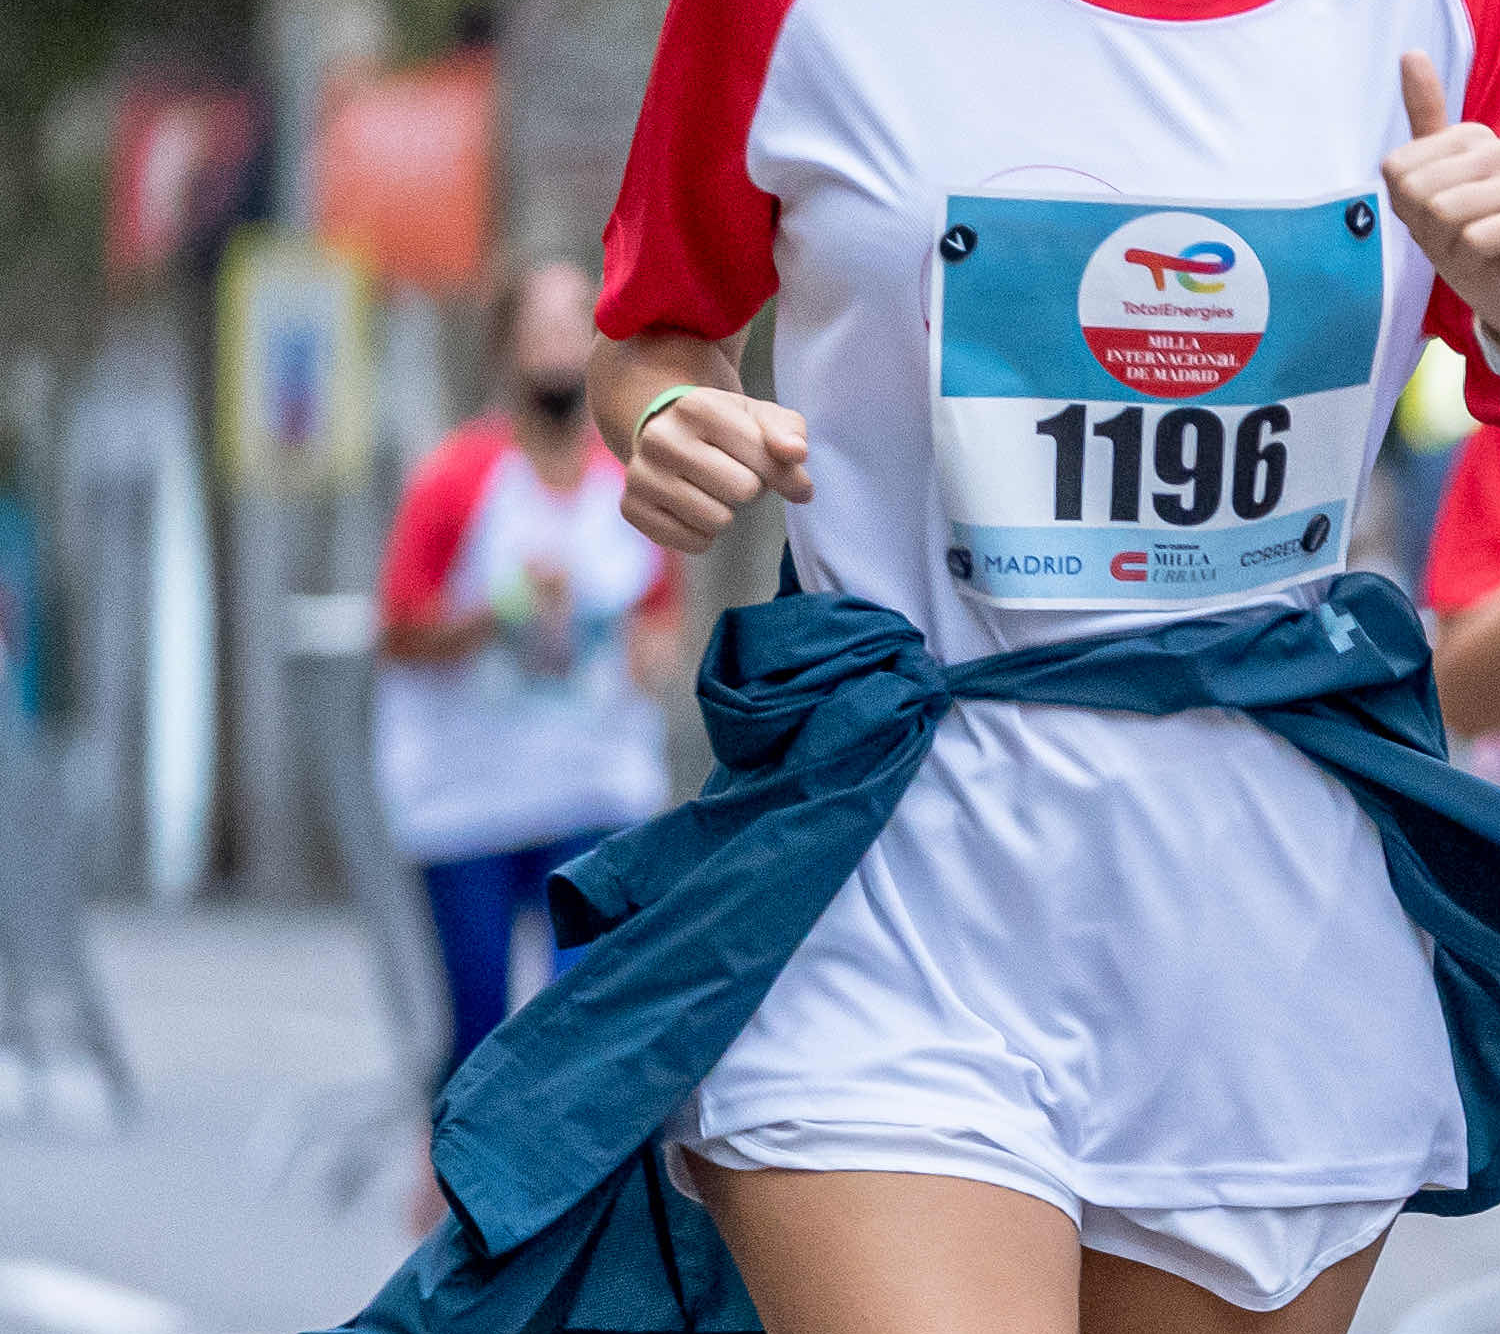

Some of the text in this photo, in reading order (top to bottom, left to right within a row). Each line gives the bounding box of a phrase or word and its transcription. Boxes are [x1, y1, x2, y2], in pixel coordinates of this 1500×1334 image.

[1122, 301, 1234, 321] TotalEnergies
[1147, 334, 1202, 349] MILLA
[1126, 366, 1220, 383] DE MADRID
[1036, 404, 1291, 526] 1196
[984, 554, 1082, 575] MADRID
